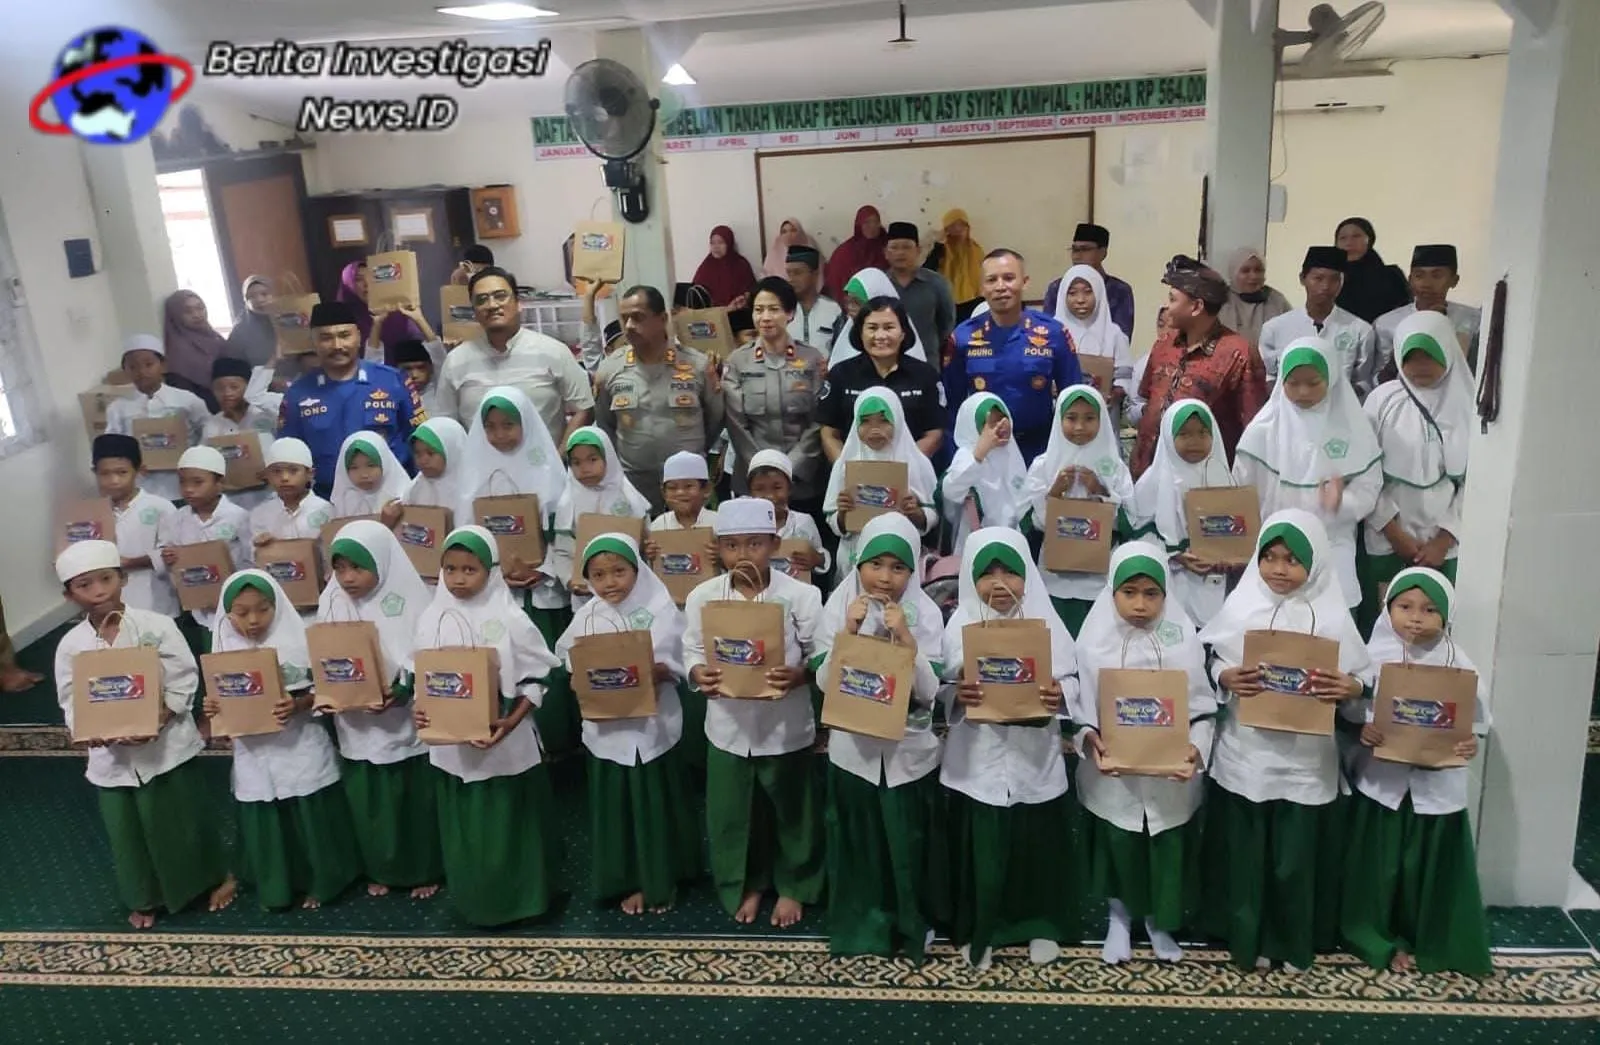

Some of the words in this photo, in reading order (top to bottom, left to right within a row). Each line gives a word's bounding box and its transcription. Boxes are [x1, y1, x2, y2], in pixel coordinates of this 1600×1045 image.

[533, 117, 585, 144] DAFTA
[665, 108, 722, 136] BELIAN
[726, 105, 769, 133] TANAH
[770, 102, 819, 131] WAKAF
[823, 97, 901, 127] PERLUASAN
[904, 95, 932, 122] TPQ
[935, 93, 963, 120] ASY
[1084, 81, 1132, 110] HARGA
[1135, 80, 1155, 107] RP
[541, 147, 587, 158] JANUARI
[665, 140, 692, 150] ARET
[717, 137, 748, 148] APRIL
[780, 135, 799, 144] MEI
[834, 131, 861, 141] JUNI
[895, 127, 919, 137] JULI
[939, 122, 991, 134] AGUSTUS
[997, 117, 1053, 130] SEPTEMBER
[1059, 114, 1112, 126] OKTOBER
[1119, 109, 1177, 122] NOVEMBER
[1181, 107, 1206, 118] DESE
[967, 348, 993, 357] AGUNG
[1024, 347, 1053, 357] POLRI
[364, 401, 396, 410] POLRI
